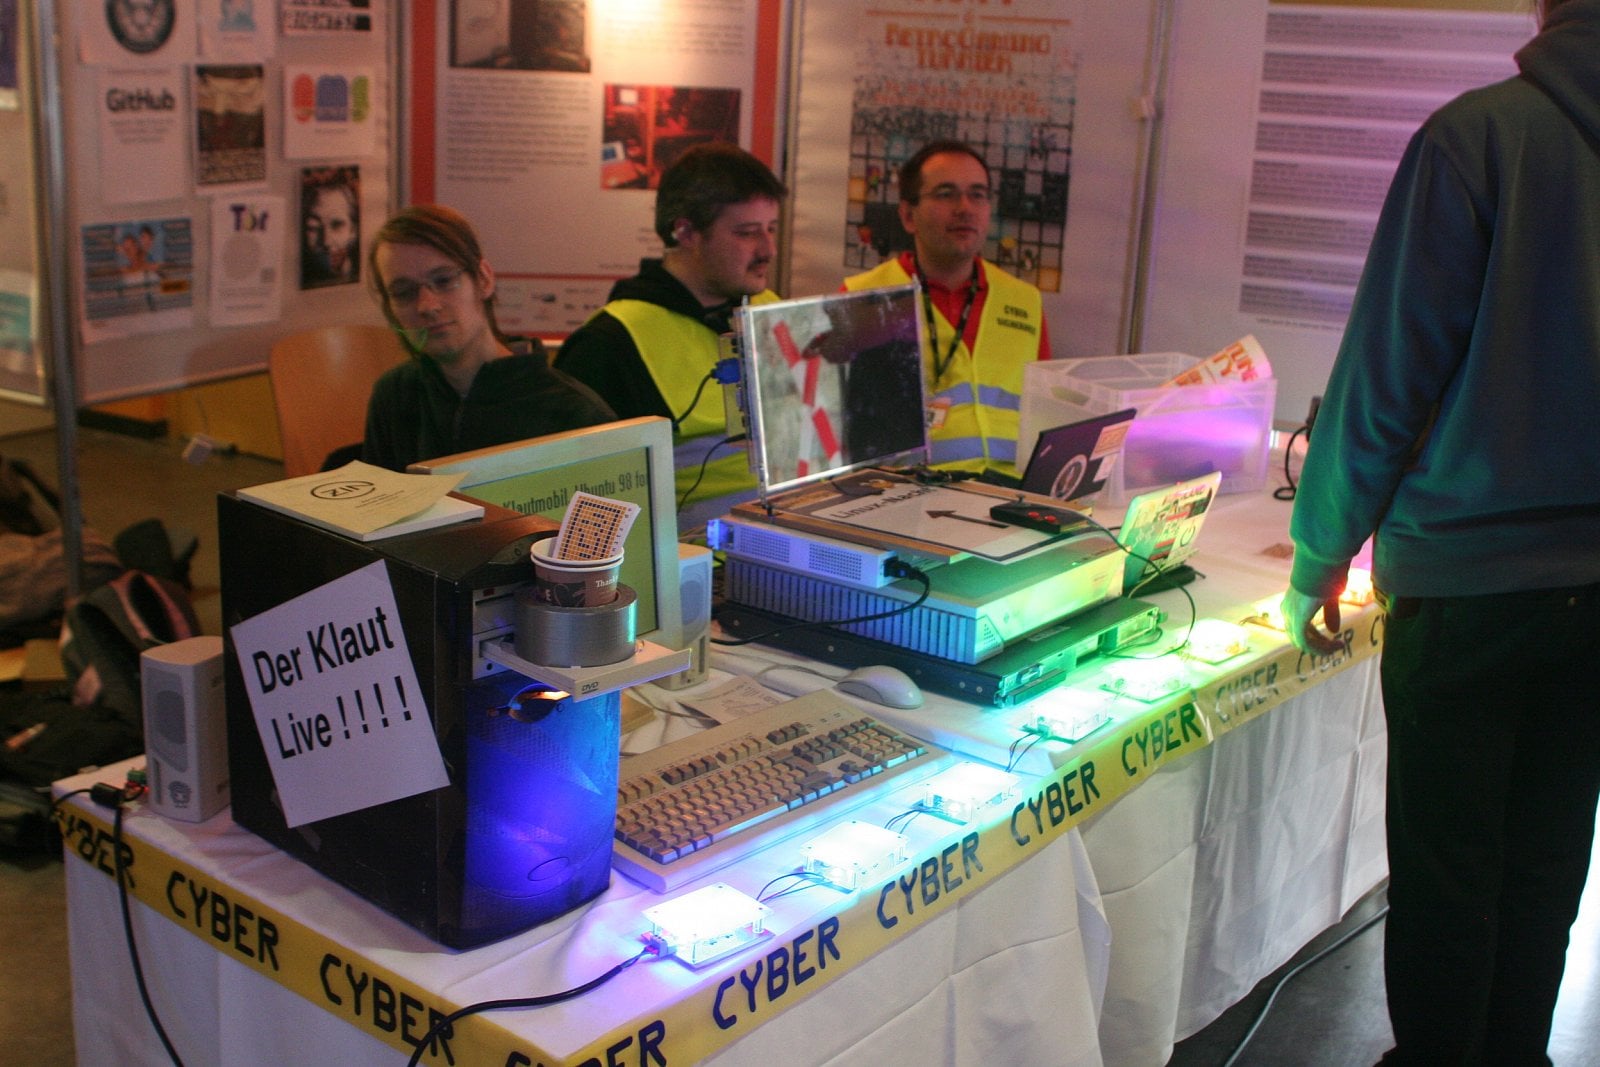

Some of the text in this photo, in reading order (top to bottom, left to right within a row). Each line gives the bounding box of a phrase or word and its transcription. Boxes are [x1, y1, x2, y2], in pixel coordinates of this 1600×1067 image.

[105, 87, 176, 112] GitHub
[618, 472, 633, 493] 98
[252, 606, 396, 694] Der Klaut
[1215, 661, 1280, 724] CYBER
[1121, 702, 1202, 778] CYBER
[1010, 761, 1101, 847] CYBER
[166, 870, 280, 971] CYBER
[877, 831, 984, 930] CYBER
[319, 952, 455, 1066] CYBER
[712, 916, 841, 1031] CYBER
